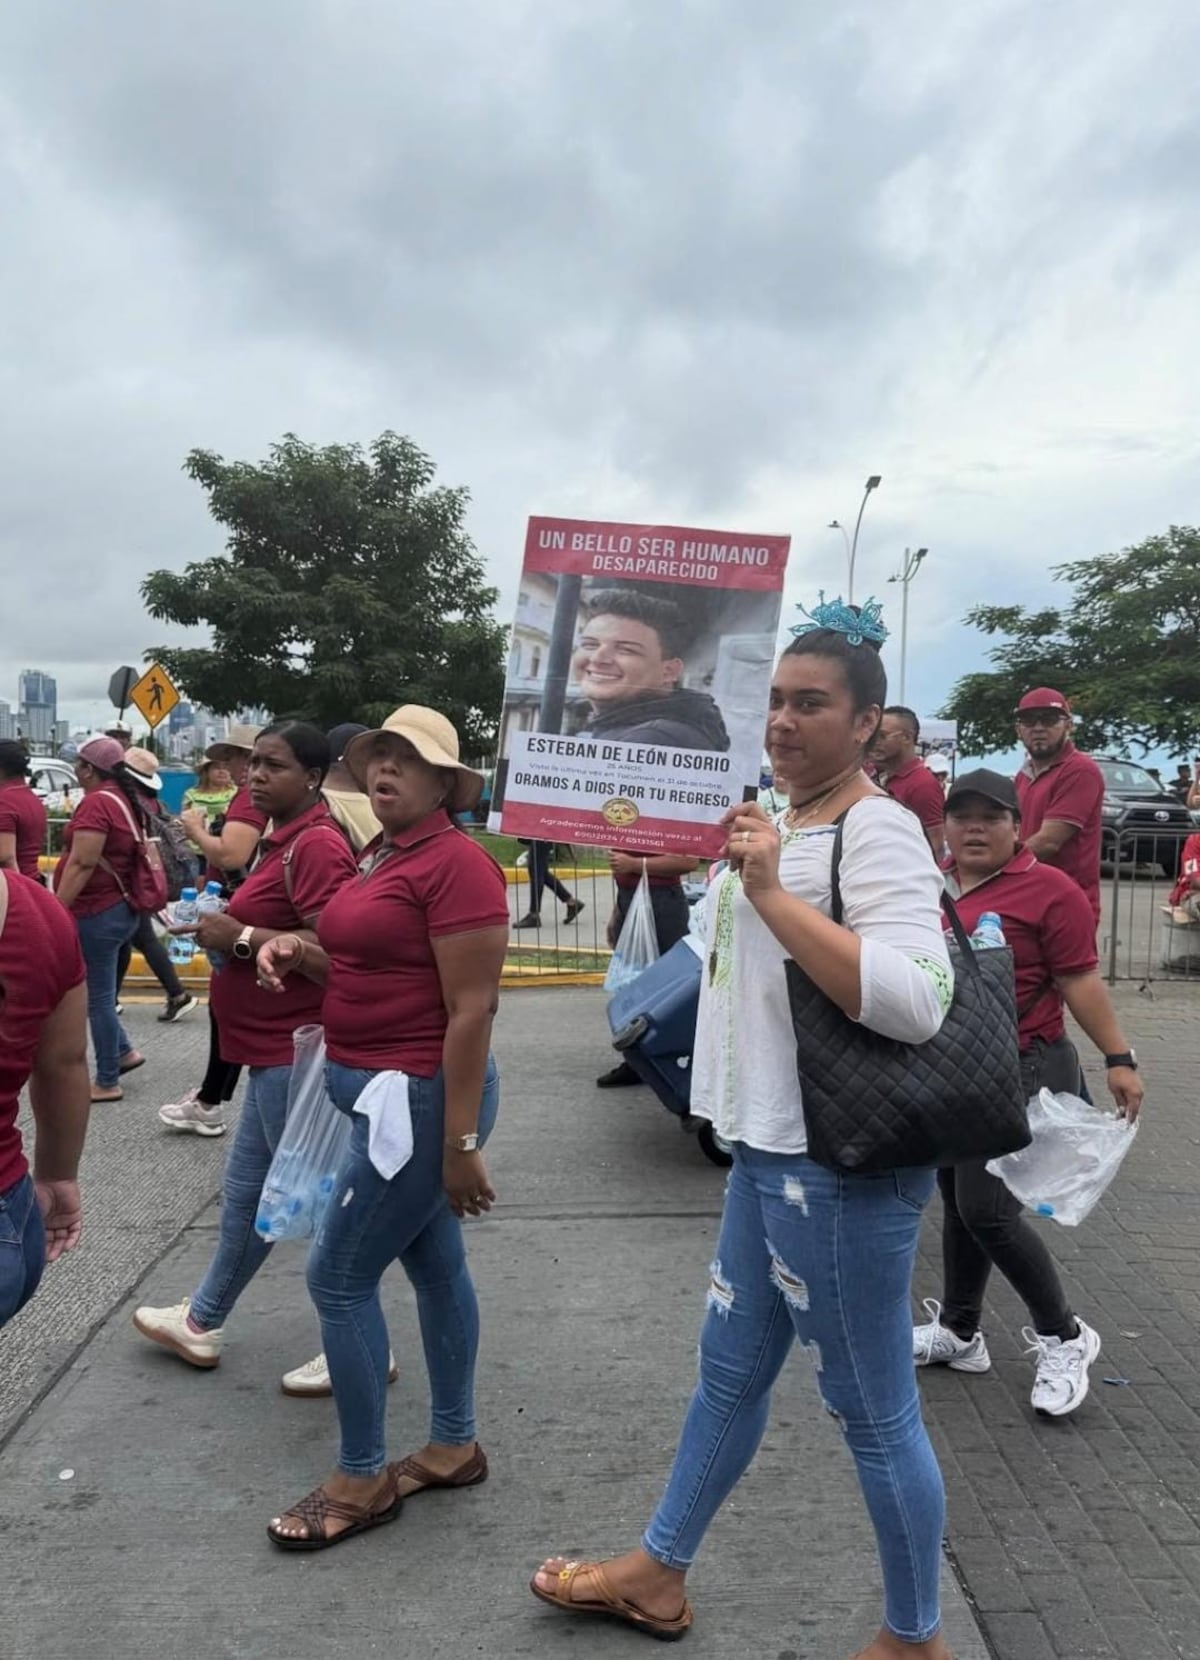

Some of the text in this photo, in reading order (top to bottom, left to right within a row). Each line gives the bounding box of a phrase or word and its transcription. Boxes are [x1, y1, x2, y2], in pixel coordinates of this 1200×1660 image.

[539, 530, 769, 566] UN BELLO SER HUMANO
[592, 555, 718, 581] DESAPARECIDO
[527, 737, 730, 772] ESTEBAN DE LEÓN OSORIO
[515, 772, 569, 790] ORAMOS
[572, 780, 581, 792] A
[585, 780, 615, 795] DIOS
[619, 784, 645, 799] POR
[649, 787, 665, 801] TU
[540, 818, 604, 831] Agradecemos
[606, 825, 663, 838] información
